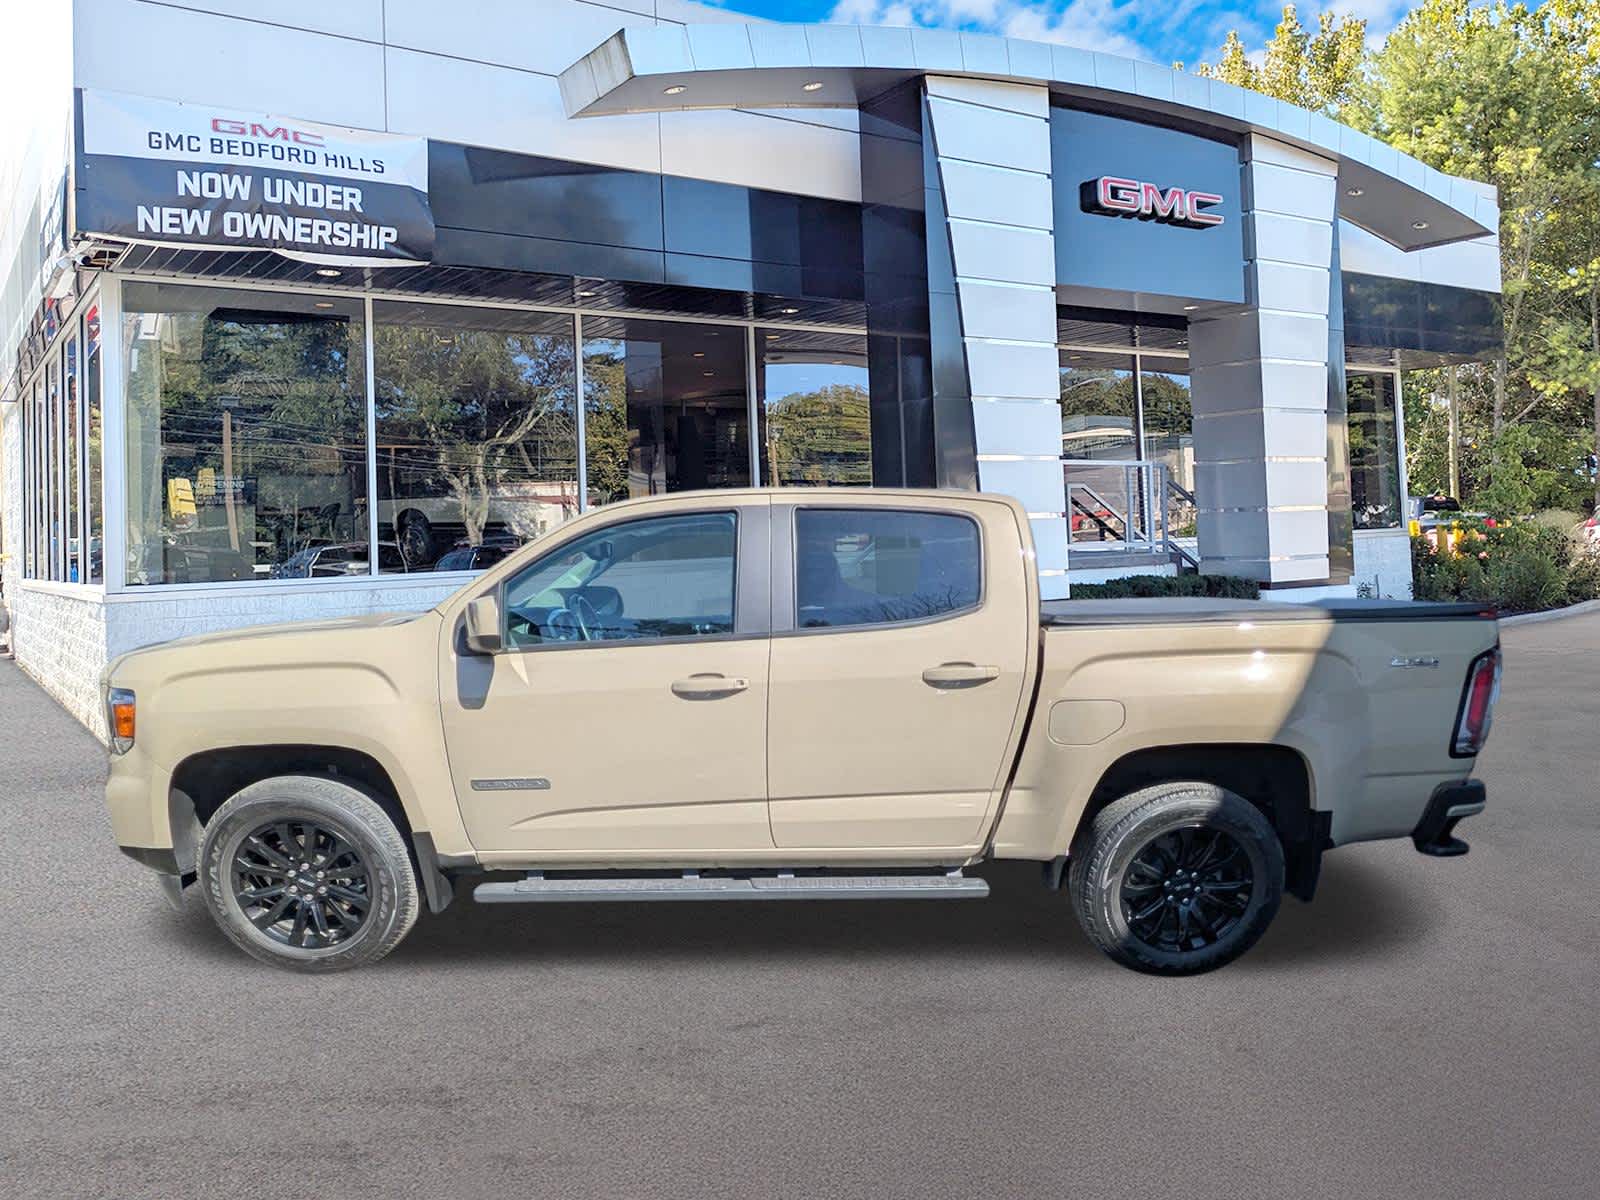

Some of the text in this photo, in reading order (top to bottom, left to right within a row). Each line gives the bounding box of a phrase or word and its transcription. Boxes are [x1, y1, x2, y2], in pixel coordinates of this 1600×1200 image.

[147, 131, 385, 174] GMC BEDFORD HILLS
[211, 118, 326, 147] GMC
[177, 171, 363, 212] NOW UNDER
[1097, 176, 1225, 225] GMC
[136, 205, 398, 249] NEW OWNERSHIP
